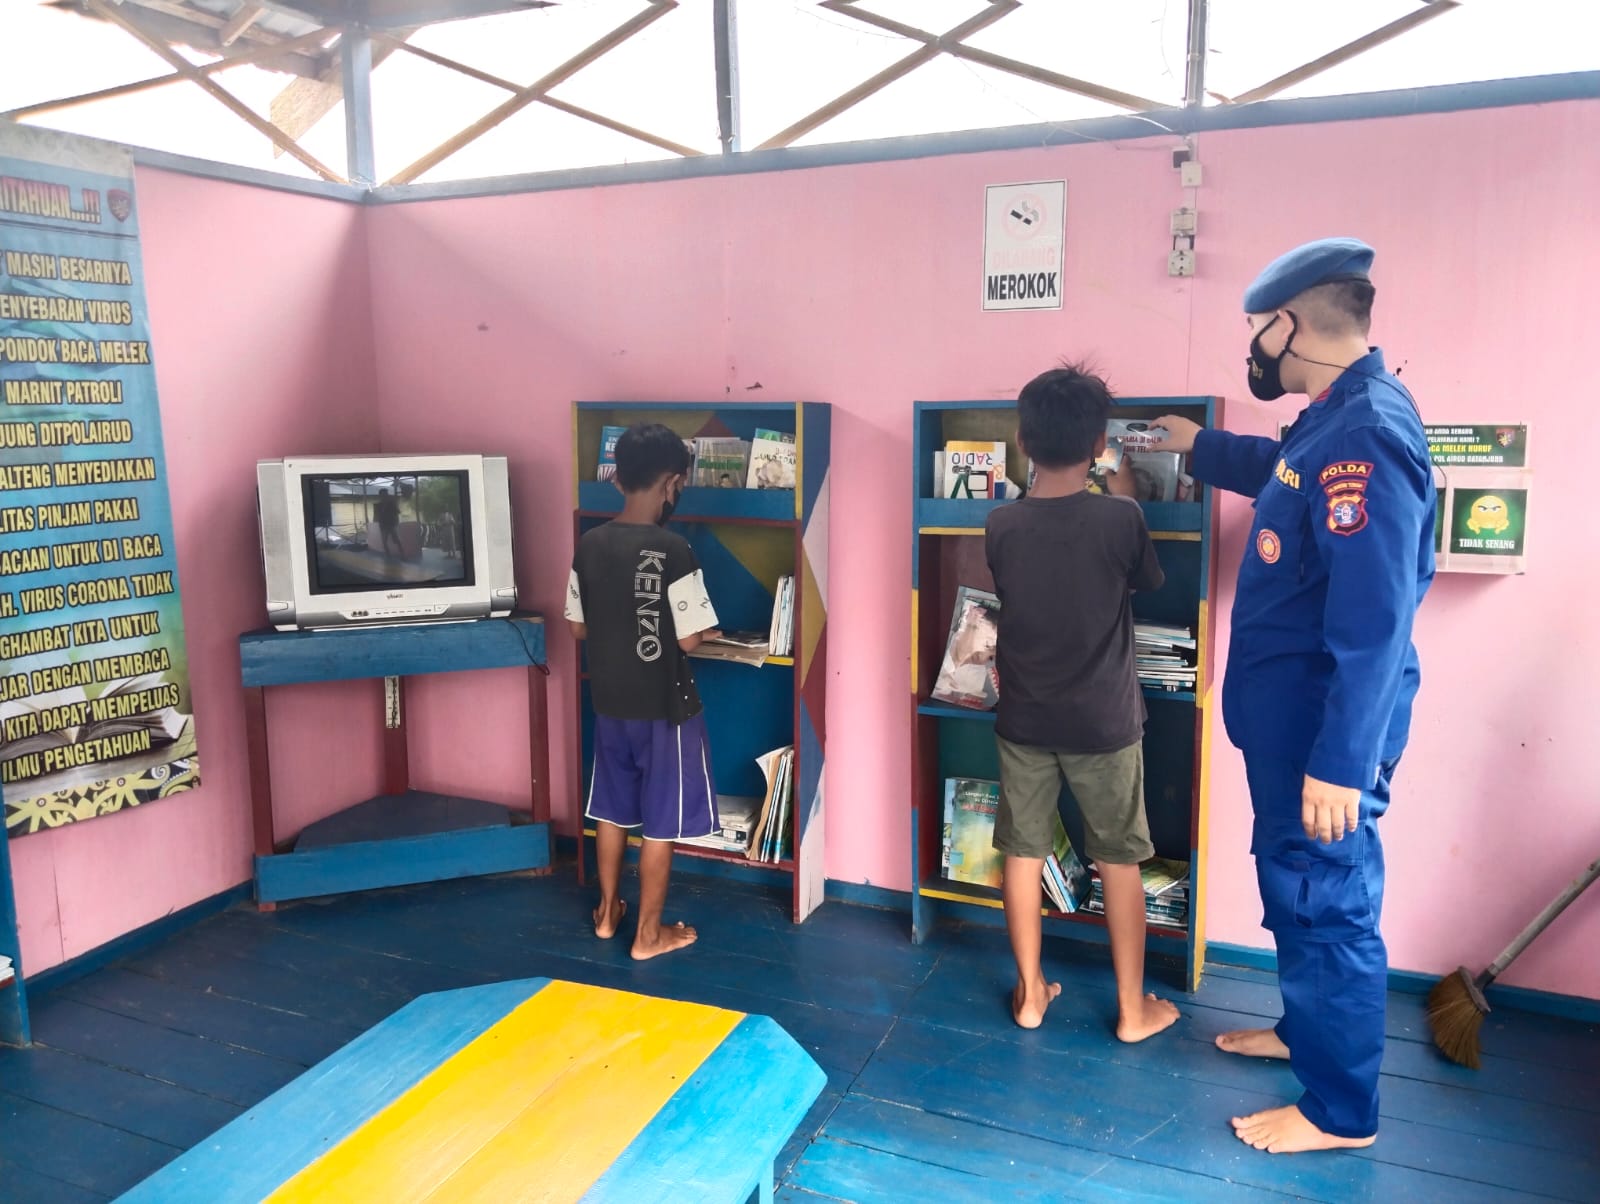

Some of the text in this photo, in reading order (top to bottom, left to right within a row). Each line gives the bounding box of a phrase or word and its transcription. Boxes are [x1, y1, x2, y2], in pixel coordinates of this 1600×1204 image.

[6, 251, 133, 285] MASIH BESARNYA
[987, 272, 1057, 301] MEROKOK
[87, 300, 133, 325] VIRUS
[60, 339, 98, 364] BACA
[100, 341, 150, 364] MELEK
[5, 379, 123, 405] MARNIT PATROLI
[40, 420, 133, 446] DITPOLAIRUD
[54, 457, 156, 487] MENYEDIAKAN
[952, 453, 993, 466] RADIO
[1321, 464, 1367, 480] POLDA
[37, 500, 91, 530] PINJAM
[94, 497, 139, 524] PAKAI
[0, 534, 162, 576] ACAAN UNTUK DI BACA
[1458, 538, 1515, 550] TIDAK SENANG
[20, 584, 65, 614] VIRUS
[66, 576, 130, 607] CORONA
[131, 570, 174, 598] TIDAK
[634, 549, 667, 662] KENZO
[73, 618, 109, 646] KITA
[109, 611, 160, 640] UNTUK
[31, 660, 93, 694] DENGAN
[93, 648, 171, 683] MEMBACA
[5, 683, 180, 742] KITA DAPAT MEMPELUAS
[2, 728, 151, 784] ILMU PENGETAHUAN
